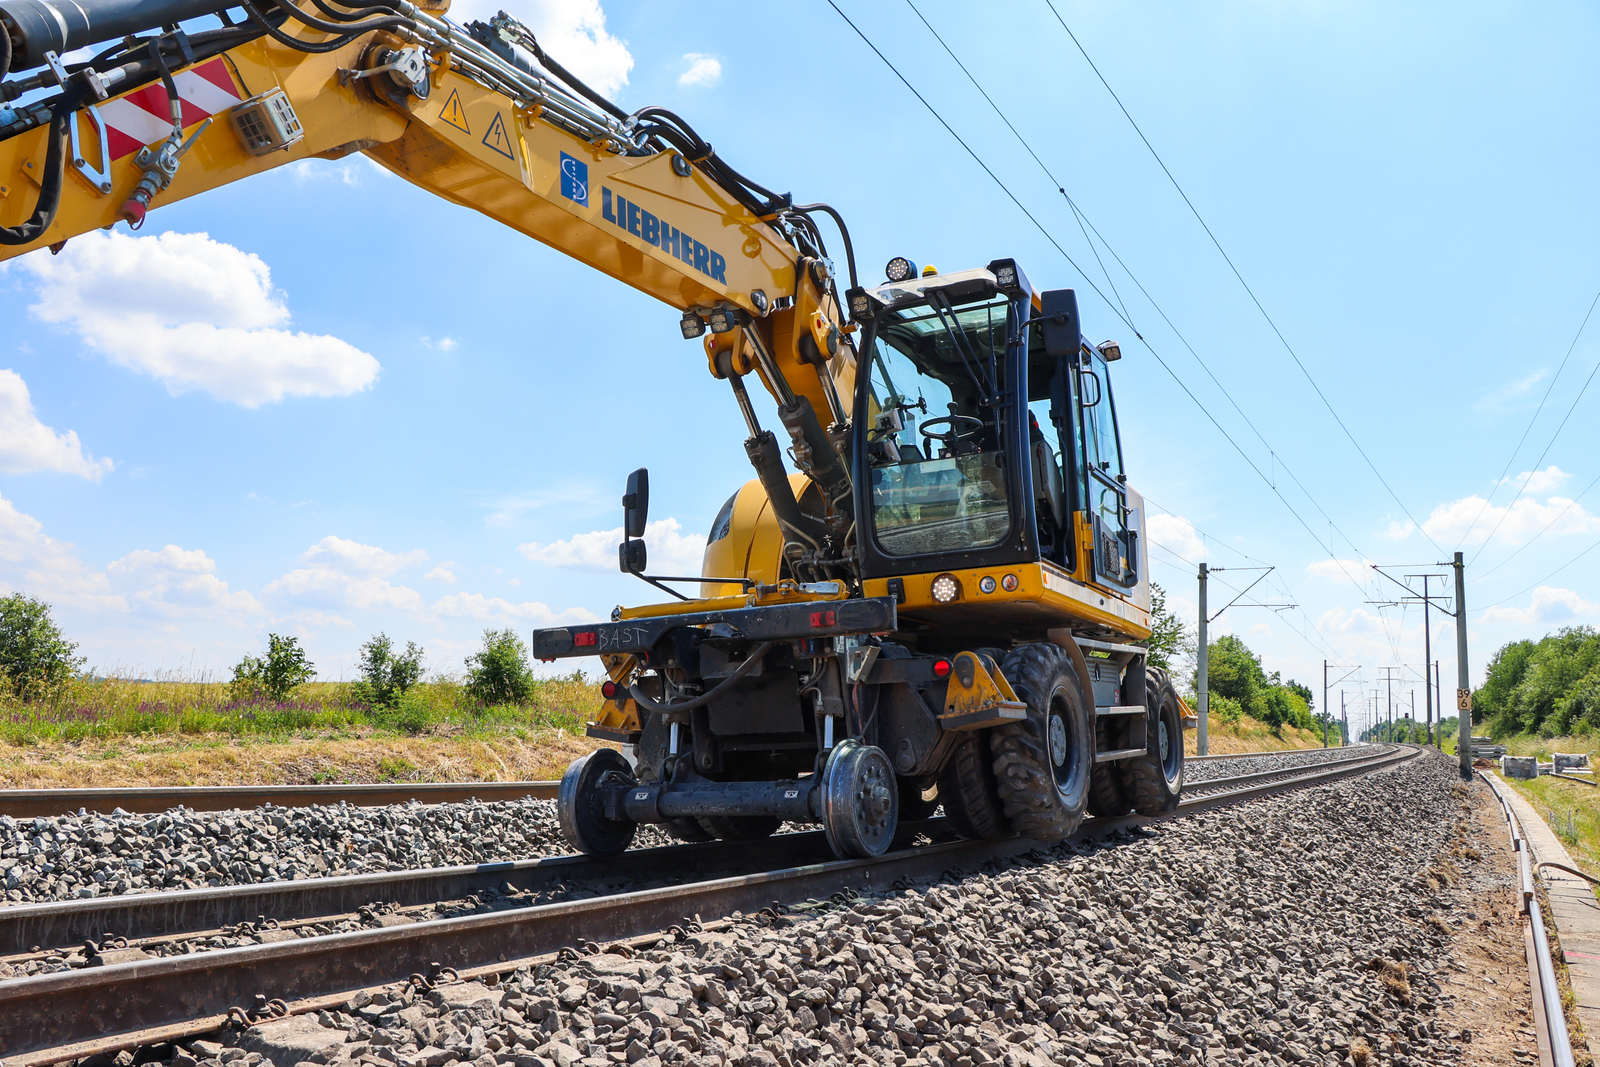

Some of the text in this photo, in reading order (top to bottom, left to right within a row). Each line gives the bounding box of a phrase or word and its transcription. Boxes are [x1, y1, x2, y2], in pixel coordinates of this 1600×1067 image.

[602, 185, 727, 286] LIEBHERR
[599, 627, 649, 651] BAST
[1458, 690, 1470, 698] 39
[1461, 699, 1467, 707] 6
